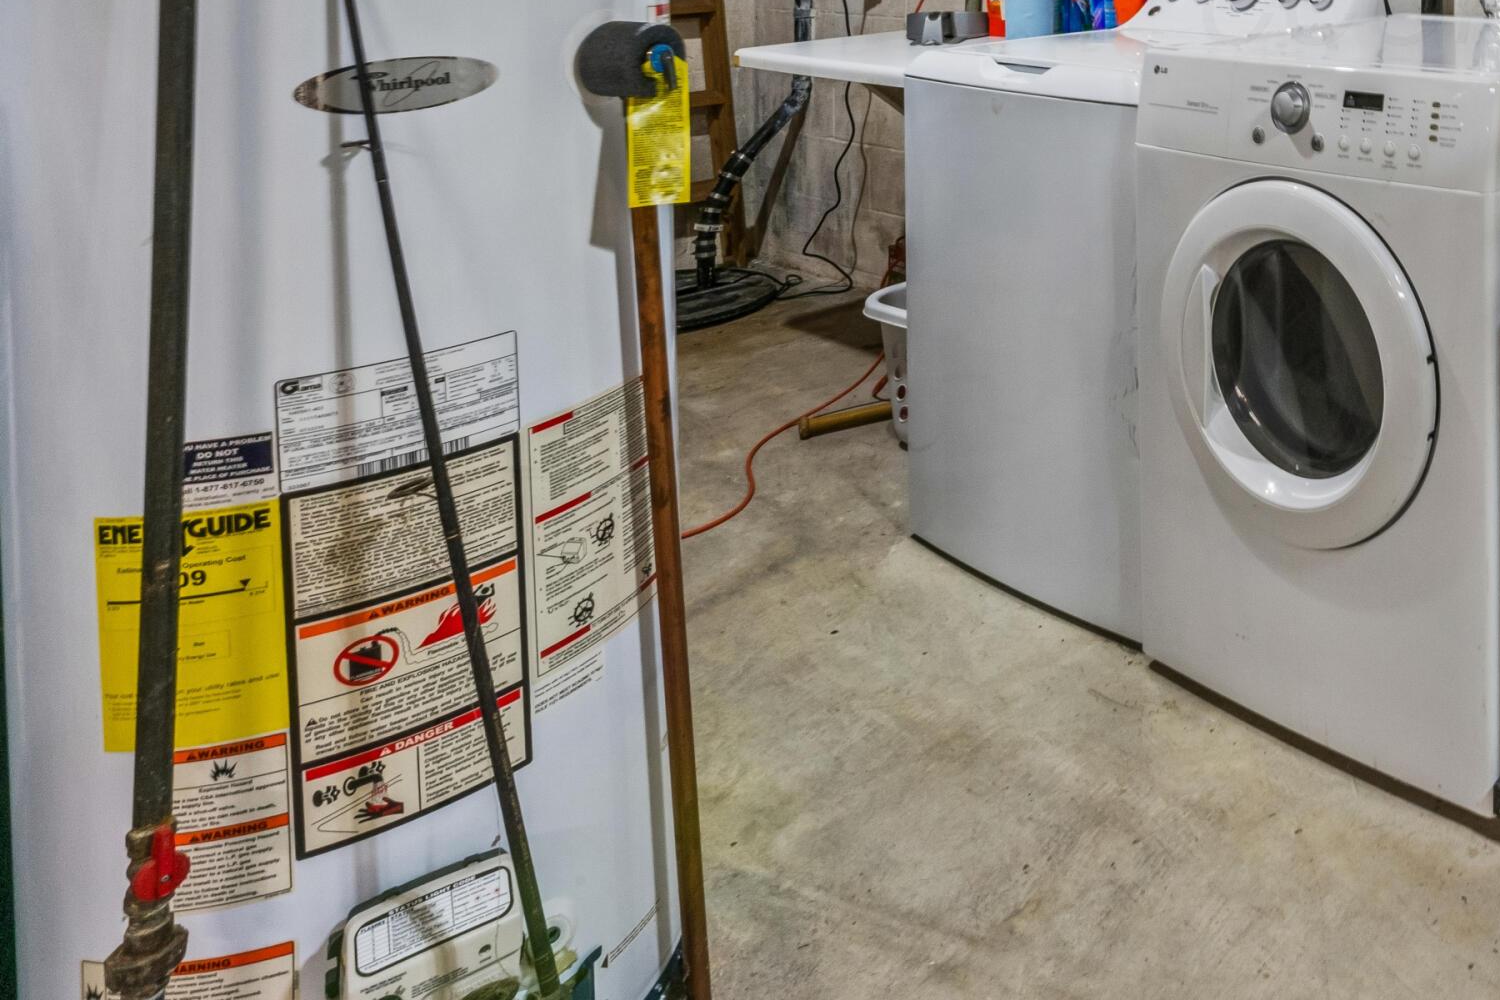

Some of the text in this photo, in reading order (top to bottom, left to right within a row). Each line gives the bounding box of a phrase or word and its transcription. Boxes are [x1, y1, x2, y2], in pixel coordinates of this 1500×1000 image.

[195, 442, 219, 450] HAVE
[196, 448, 240, 459] DO NOT
[182, 557, 224, 569] Operating
[225, 554, 246, 564] Cost
[381, 585, 451, 614] WARNING
[379, 681, 396, 689] AND
[395, 721, 454, 750] DANGER
[198, 740, 265, 759] WARNING
[201, 821, 268, 841] WARNING
